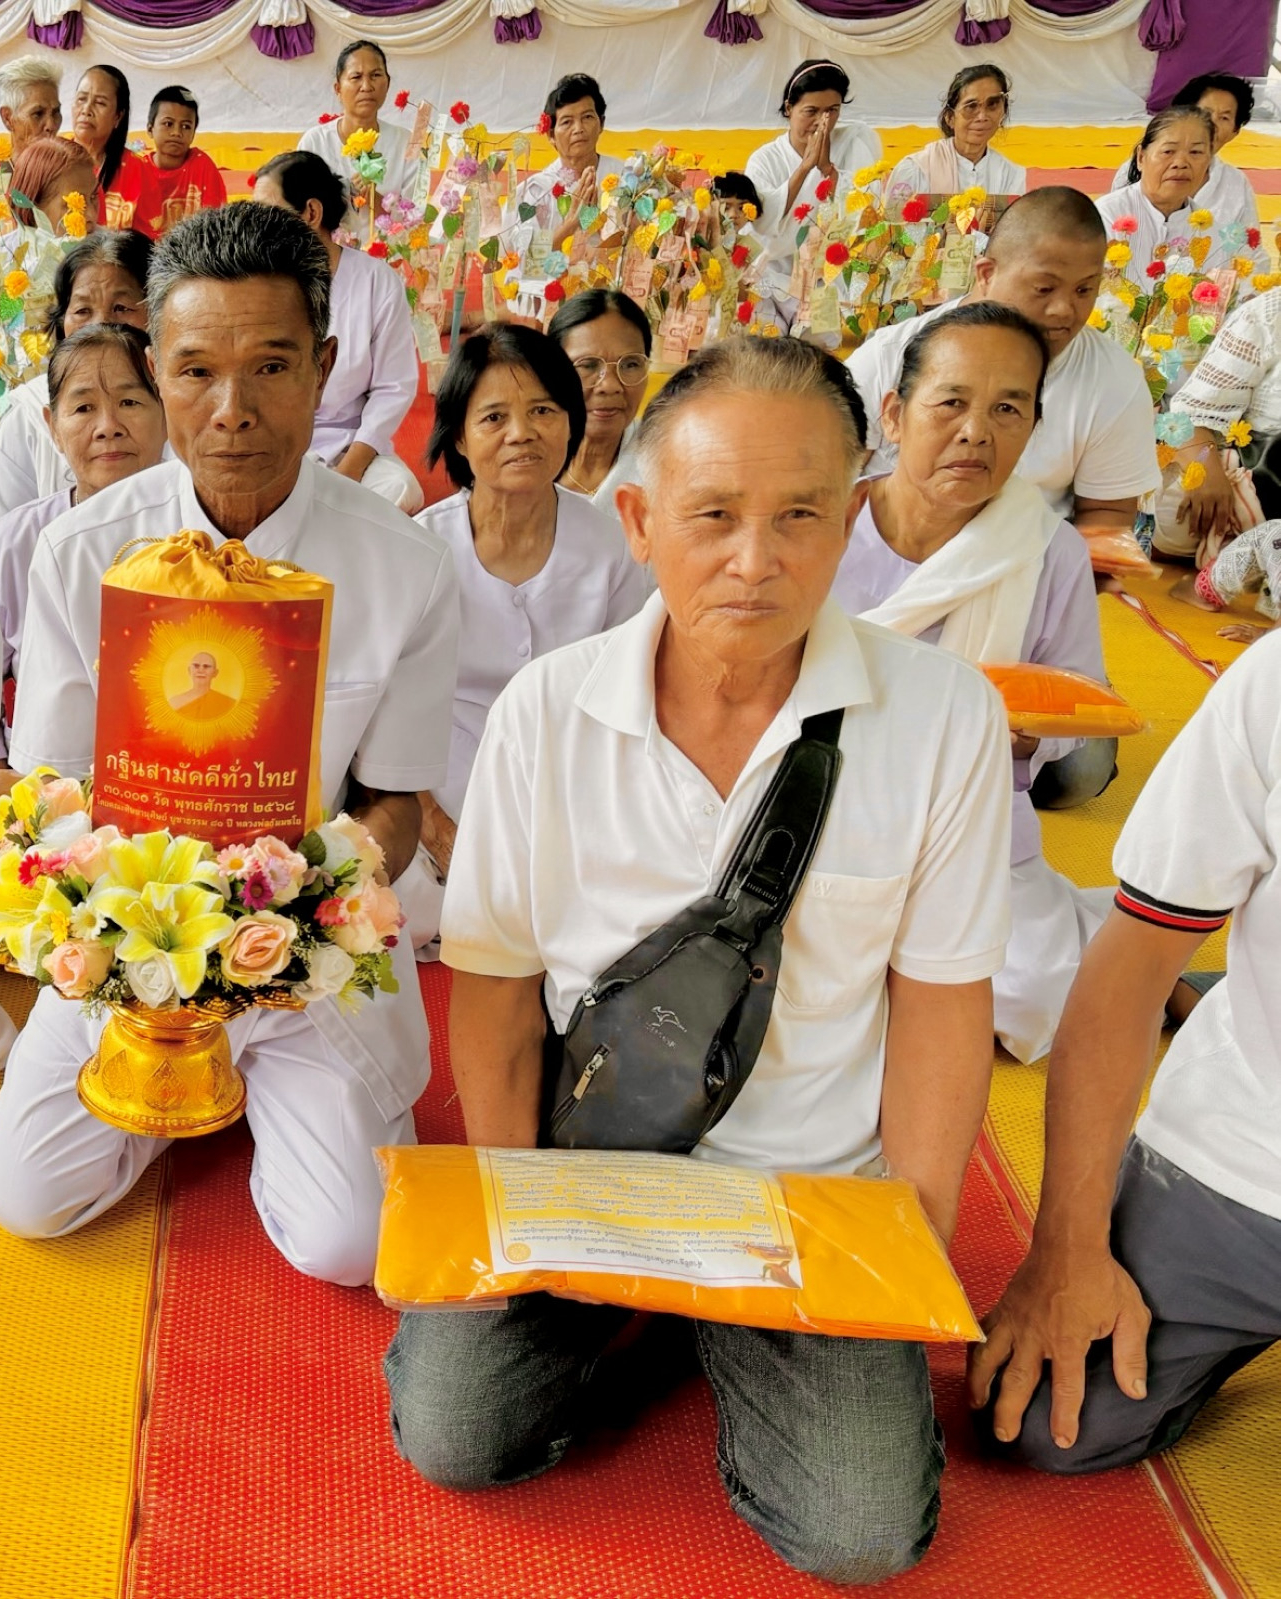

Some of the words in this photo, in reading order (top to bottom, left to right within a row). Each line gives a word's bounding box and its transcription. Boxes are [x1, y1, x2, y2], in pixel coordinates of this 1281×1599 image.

[105, 750, 298, 789] กฐินสามัคคีทั่วไทย
[152, 791, 170, 807] วัด
[174, 798, 249, 814] พุทธศักราช
[253, 800, 296, 813] ๒๕๖๘
